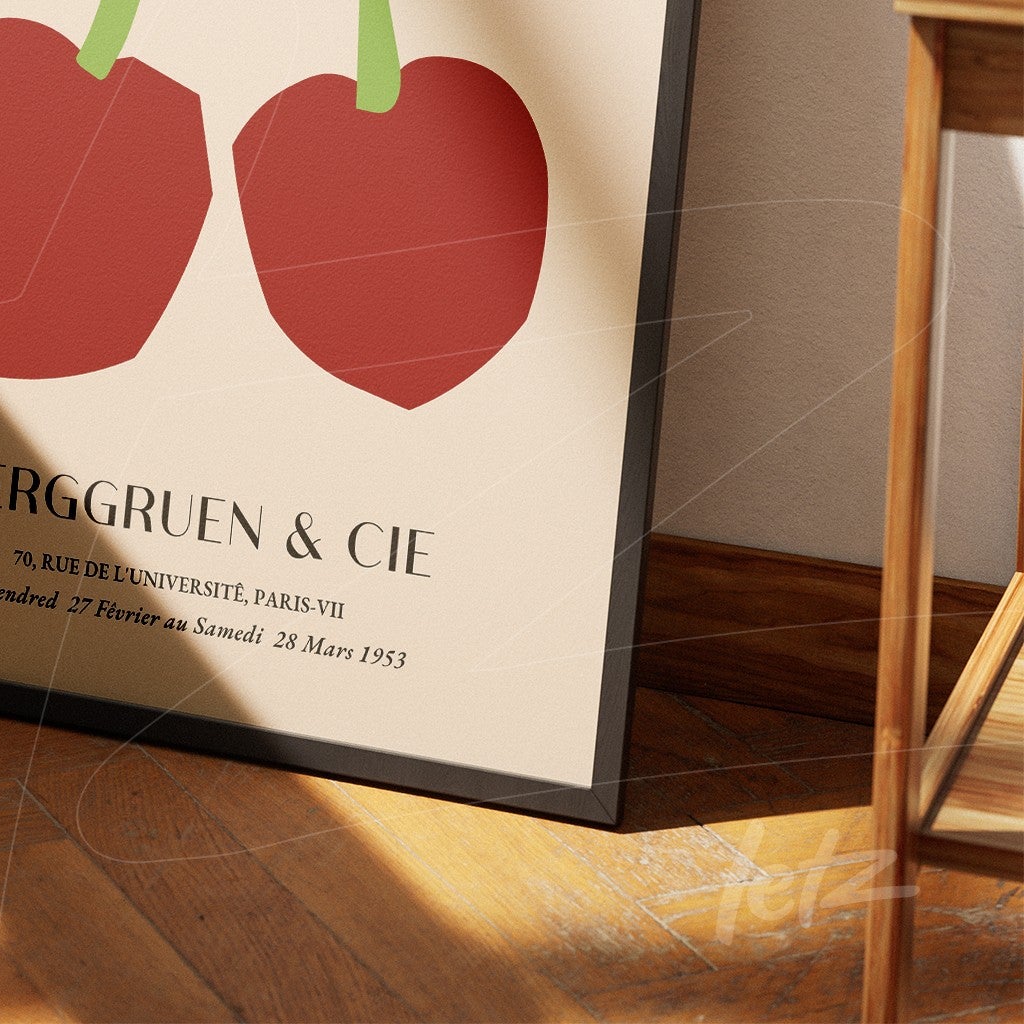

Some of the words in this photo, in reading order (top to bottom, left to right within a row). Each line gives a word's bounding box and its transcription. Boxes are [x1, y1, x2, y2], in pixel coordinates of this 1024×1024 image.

[285, 511, 323, 561] &
[347, 521, 435, 578] CIE
[13, 549, 37, 572] 70,
[40, 552, 80, 576] RUE
[83, 559, 110, 581] DE
[253, 588, 345, 620] PARIS-VII
[66, 595, 94, 615] 27
[163, 617, 188, 632] au
[192, 616, 265, 645] Samedi
[272, 631, 298, 651] 28
[301, 635, 354, 660] Mars
[359, 646, 407, 669] 1953
